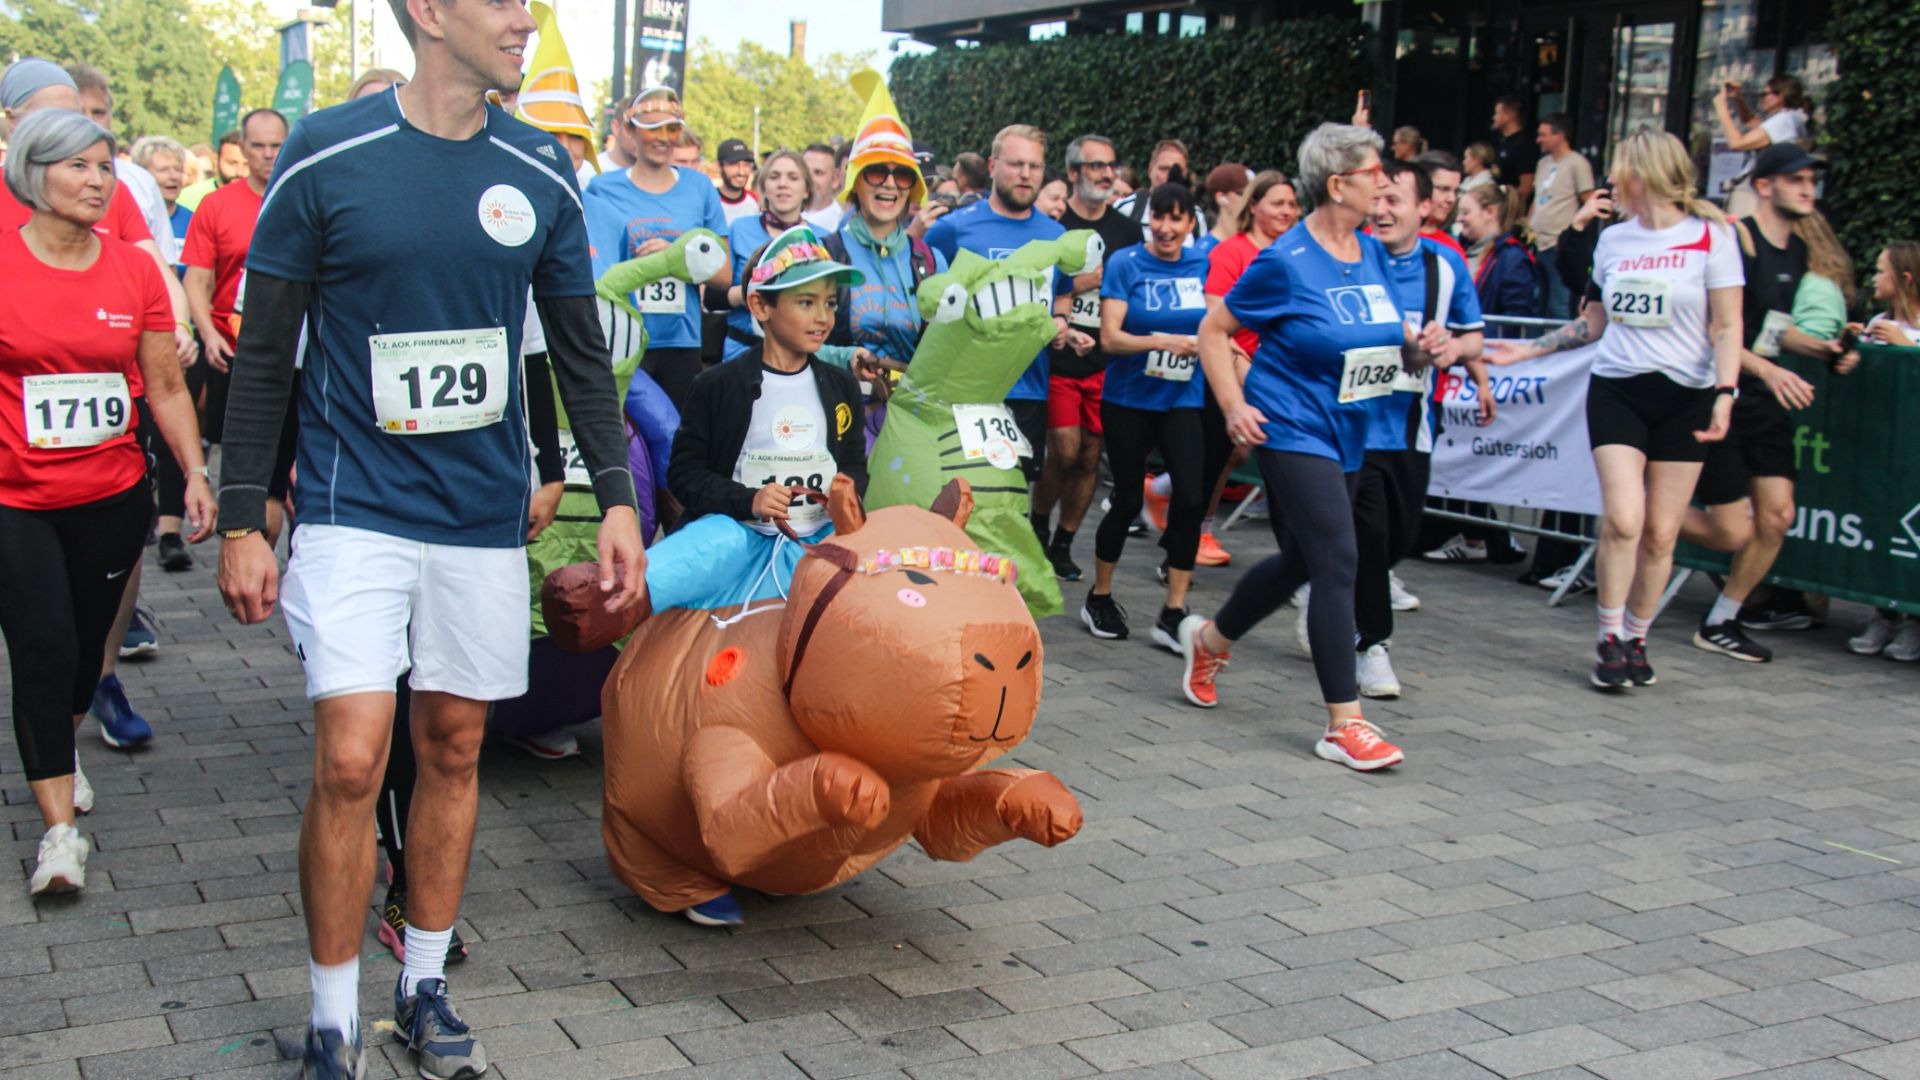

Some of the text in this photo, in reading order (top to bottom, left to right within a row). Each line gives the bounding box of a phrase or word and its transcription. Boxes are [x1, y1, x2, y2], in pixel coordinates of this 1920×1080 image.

[1617, 251, 1685, 272] avanti
[1612, 292, 1663, 314] 2231
[399, 362, 487, 409] 129
[1348, 364, 1398, 389] 1038
[34, 396, 125, 430] 1719
[974, 417, 1018, 443] 136
[1472, 436, 1558, 461] Gütersloh
[1785, 506, 1874, 551] uns.
